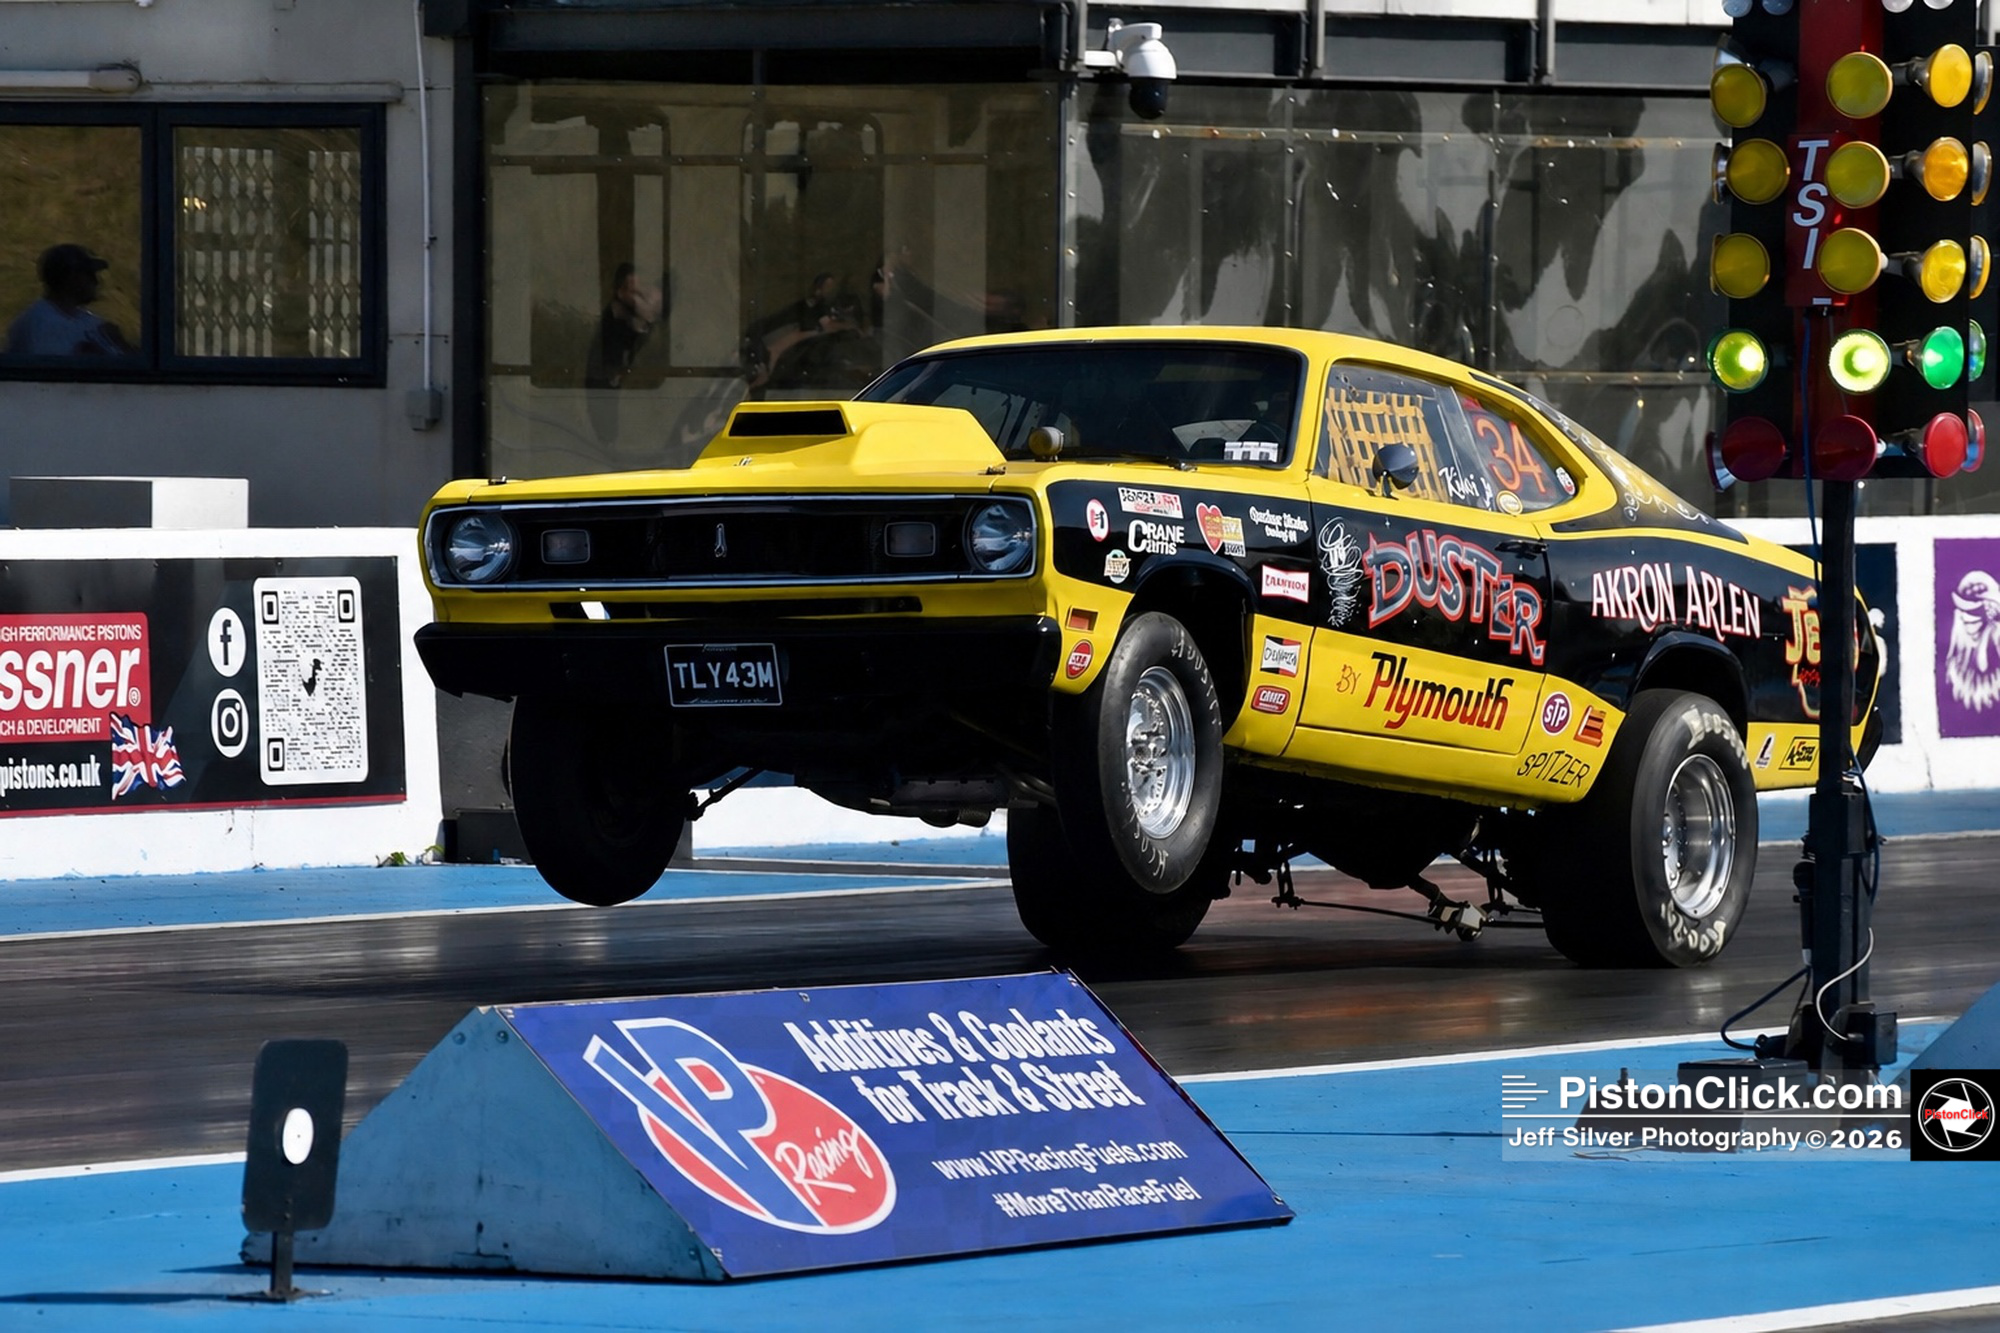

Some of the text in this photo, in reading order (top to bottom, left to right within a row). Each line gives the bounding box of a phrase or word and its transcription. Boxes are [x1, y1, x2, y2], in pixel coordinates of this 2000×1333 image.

[1475, 418, 1546, 494] 34
[1128, 519, 1185, 555] CRANE
[1362, 529, 1546, 665] DUSTER
[1591, 562, 1761, 642] AKRON ARLEN
[98, 623, 142, 641] PISTONS
[1336, 651, 1514, 731] BY Plymouth
[1544, 701, 1567, 727] STP
[27, 718, 102, 735] DEVELOPMENT
[1517, 750, 1591, 788] SPITZER
[784, 1008, 1116, 1073] Additives & Coolants
[851, 1060, 1146, 1124] for Track & Street
[774, 1126, 874, 1206] Racing
[931, 1137, 1188, 1182] www.VPRacingFuels.com
[995, 1177, 1202, 1219] #MoreThanRaceFuel
